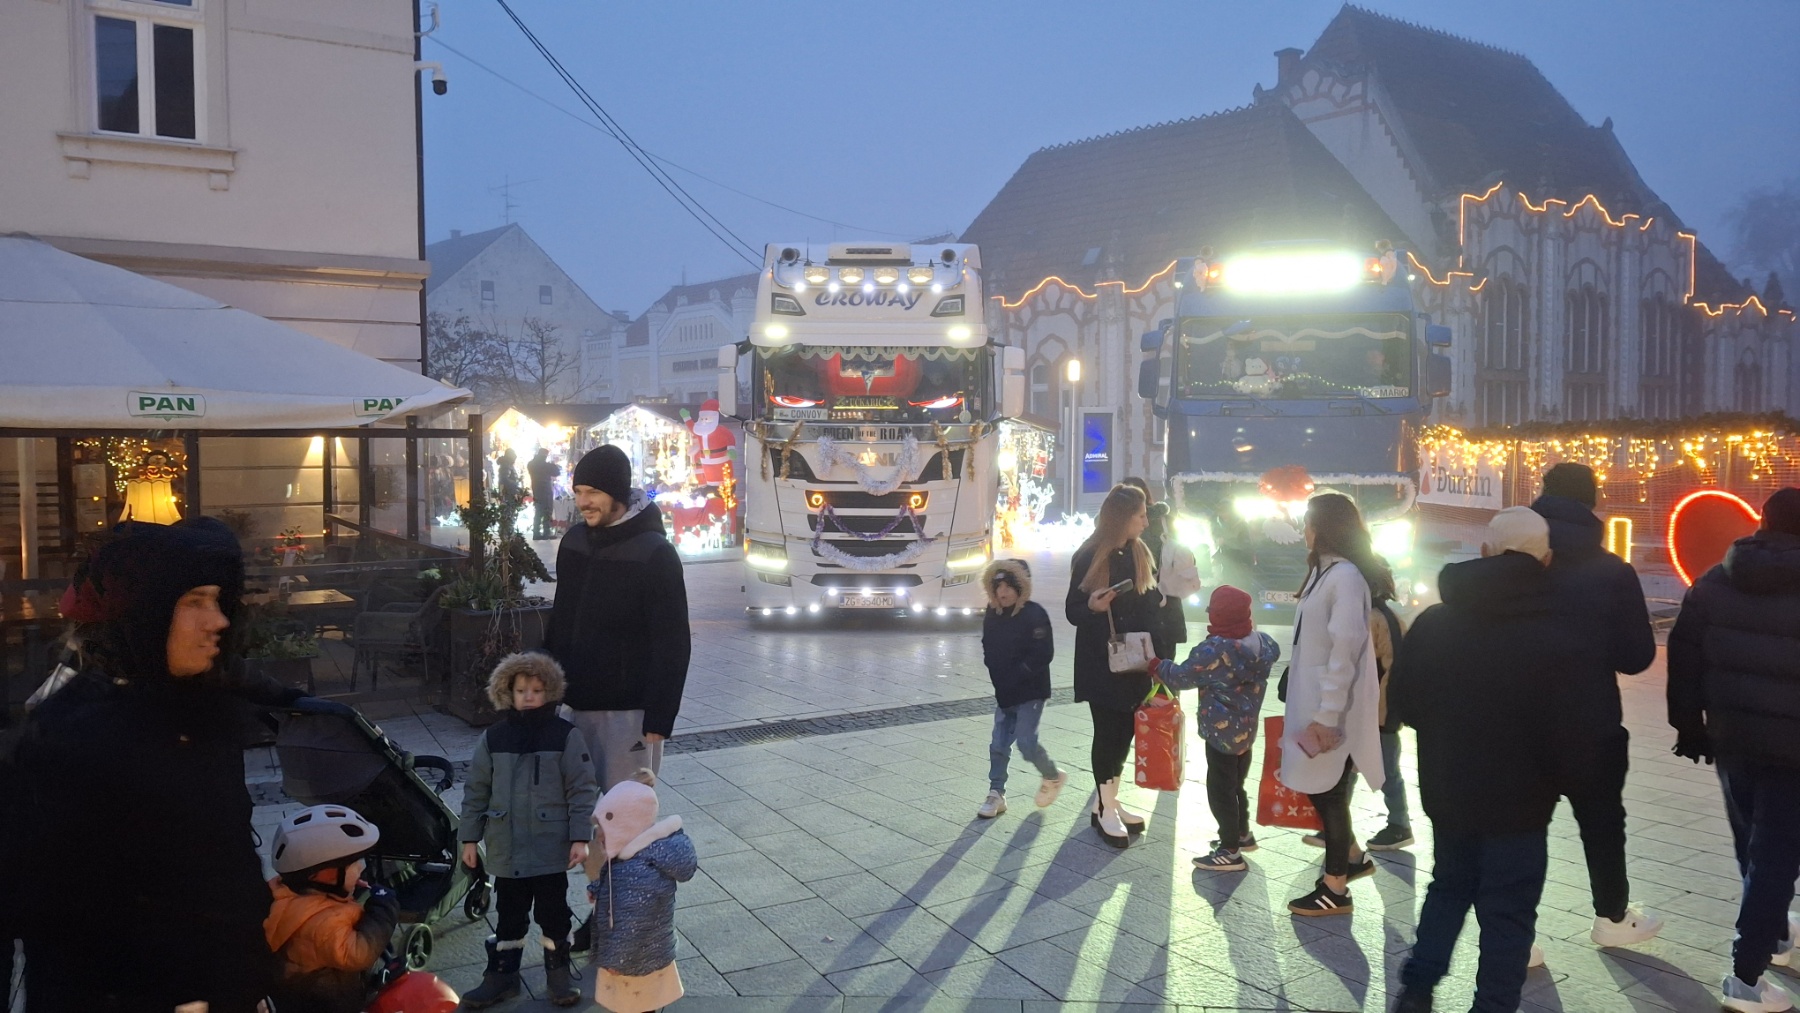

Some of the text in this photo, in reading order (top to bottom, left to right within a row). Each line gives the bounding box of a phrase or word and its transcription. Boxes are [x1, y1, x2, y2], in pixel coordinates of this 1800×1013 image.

[815, 291, 922, 311] CROWAY
[1380, 388, 1407, 397] MARIO
[138, 396, 196, 412] PAN
[791, 409, 822, 418] CONVOY
[823, 427, 854, 440] QUEEN
[1437, 466, 1492, 497] Đurkin
[845, 596, 856, 606] ZG
